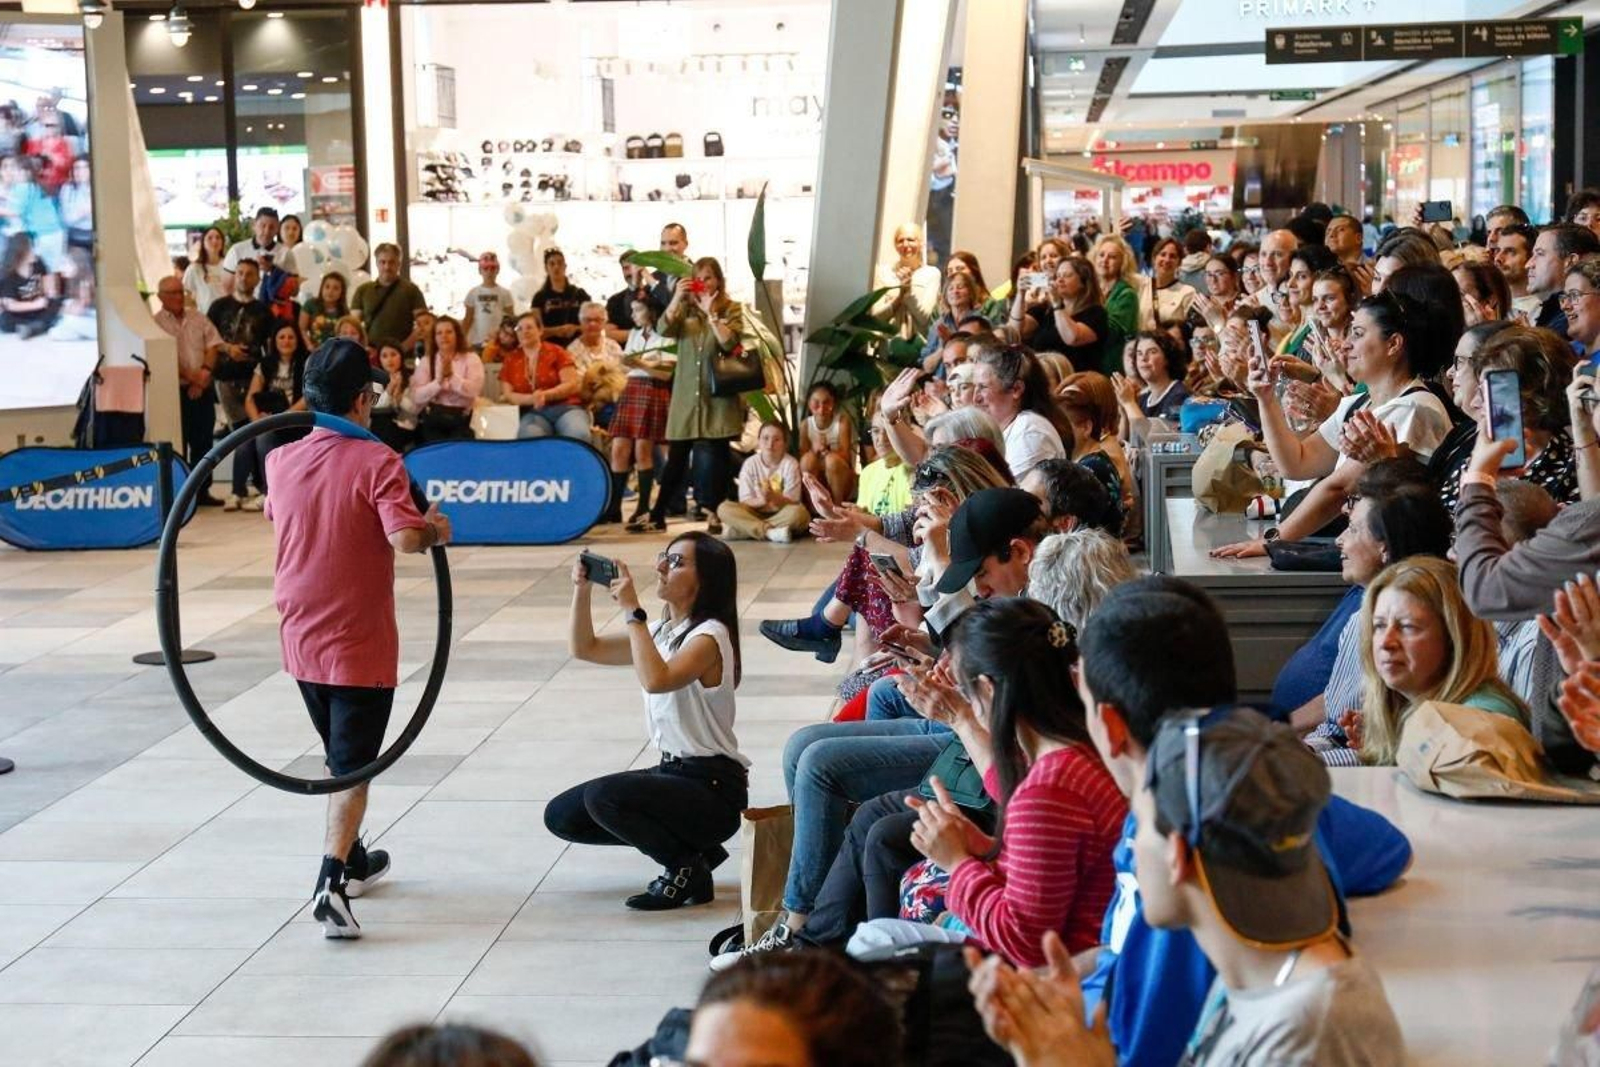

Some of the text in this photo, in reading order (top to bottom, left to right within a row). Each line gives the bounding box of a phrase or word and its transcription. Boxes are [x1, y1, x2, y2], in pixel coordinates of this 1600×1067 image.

[1239, 0, 1352, 18] PRIMARK
[15, 485, 153, 511] DECATHLON
[426, 479, 570, 503] DECATHLON
